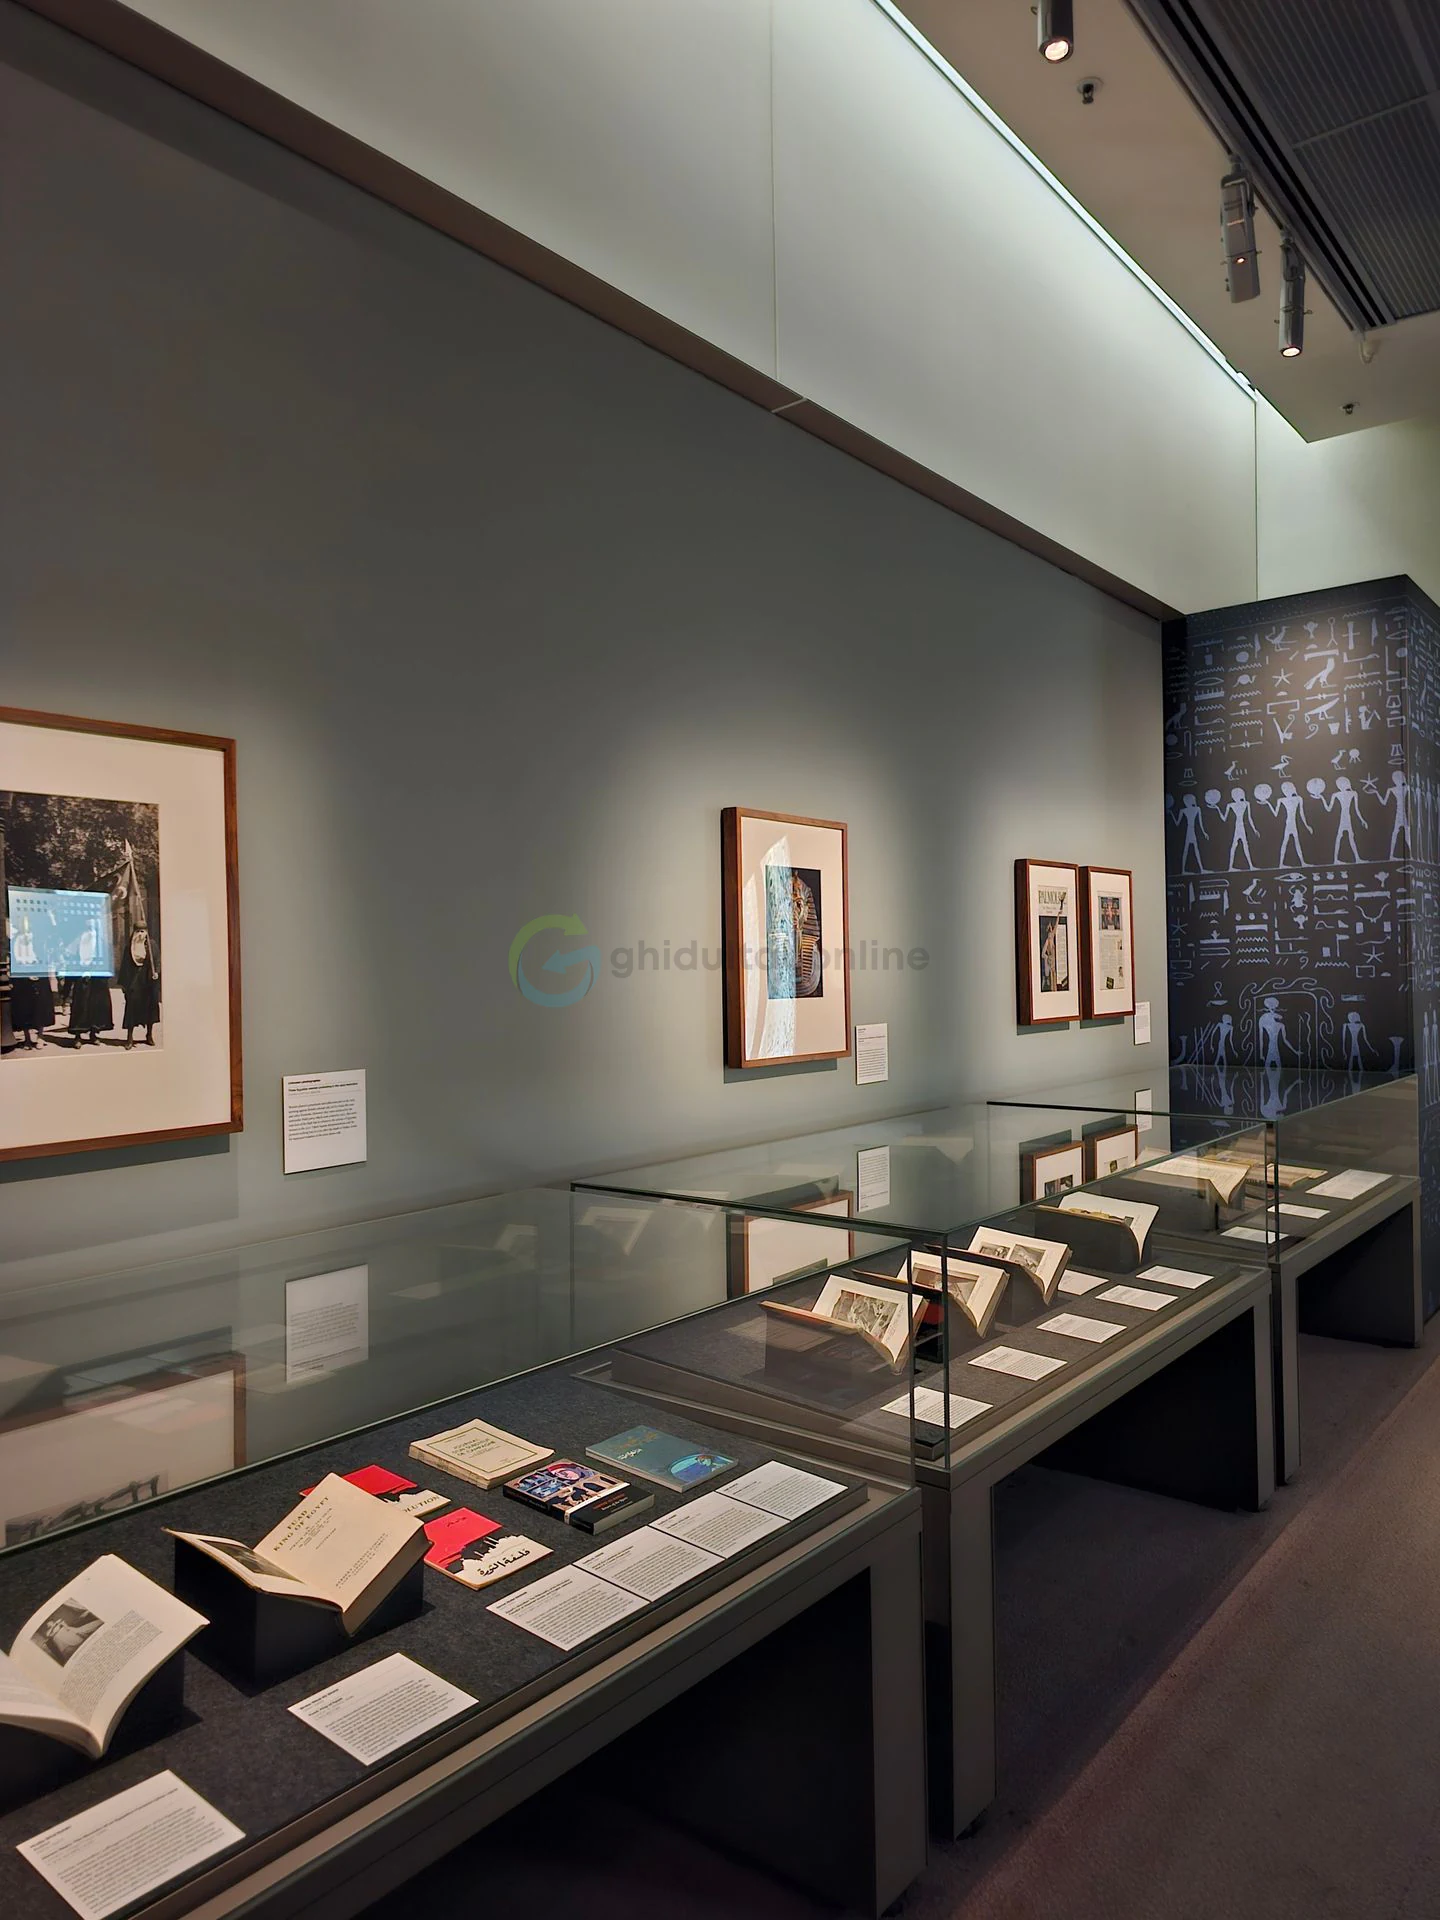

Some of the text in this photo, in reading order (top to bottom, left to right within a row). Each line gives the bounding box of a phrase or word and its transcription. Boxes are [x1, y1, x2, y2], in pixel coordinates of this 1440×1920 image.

[273, 1532, 294, 1551] KING
[294, 1521, 305, 1531] OF
[306, 1496, 329, 1519] EGYPT
